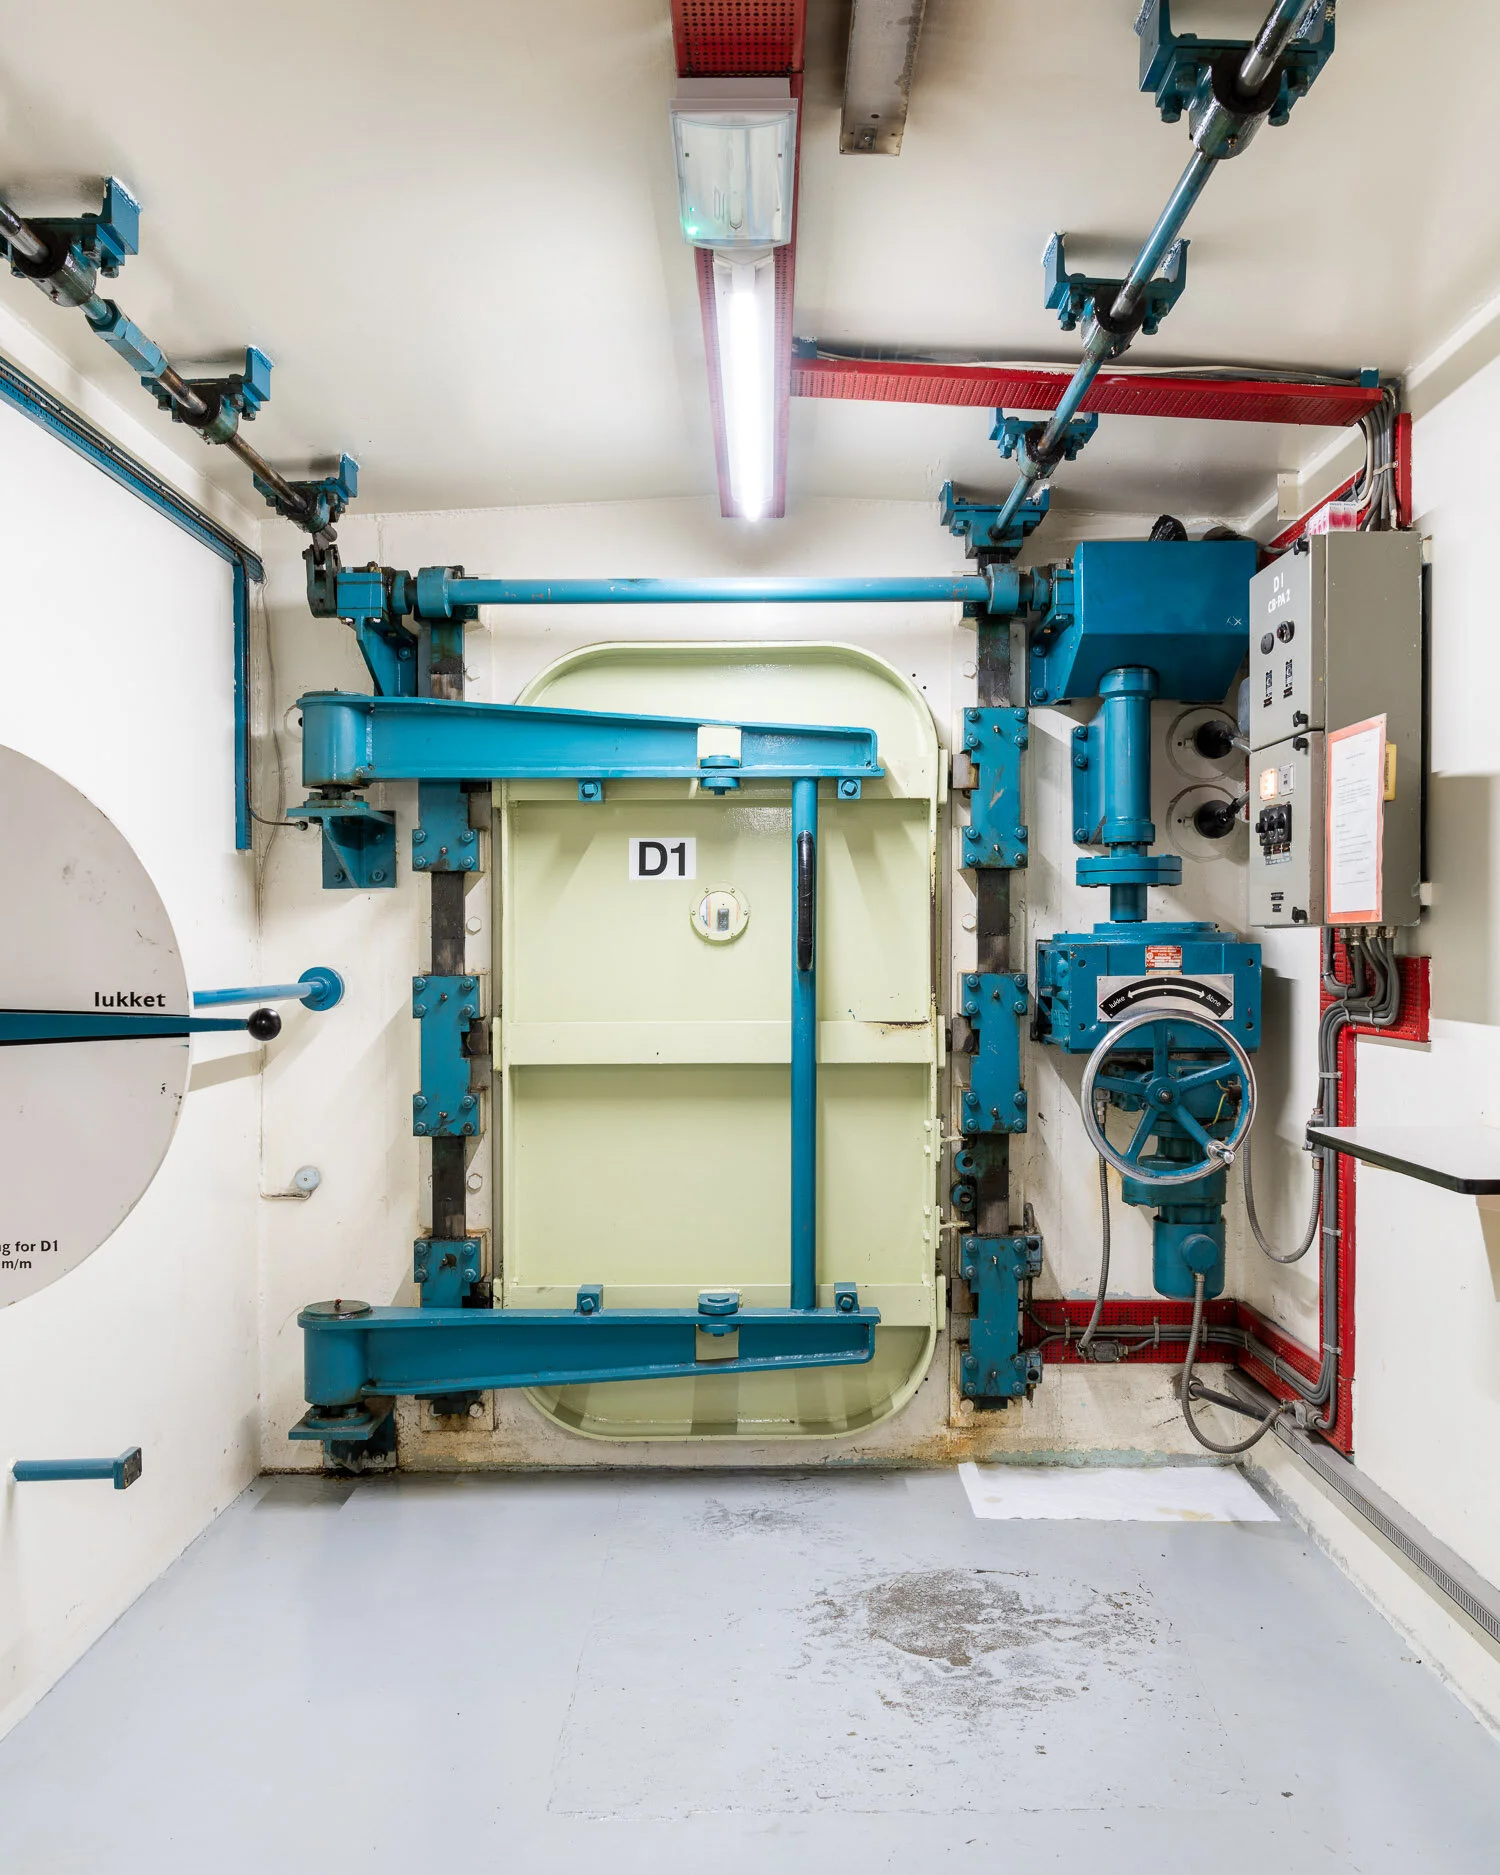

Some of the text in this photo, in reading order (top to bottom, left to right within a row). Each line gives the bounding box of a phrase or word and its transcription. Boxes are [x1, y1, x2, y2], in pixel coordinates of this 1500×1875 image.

[639, 841, 686, 876] D1
[94, 991, 166, 1007] lukket
[1108, 996, 1126, 1009] lukke
[15, 1240, 37, 1252] for
[41, 1239, 58, 1252] D1
[1, 1258, 32, 1271] m/m
